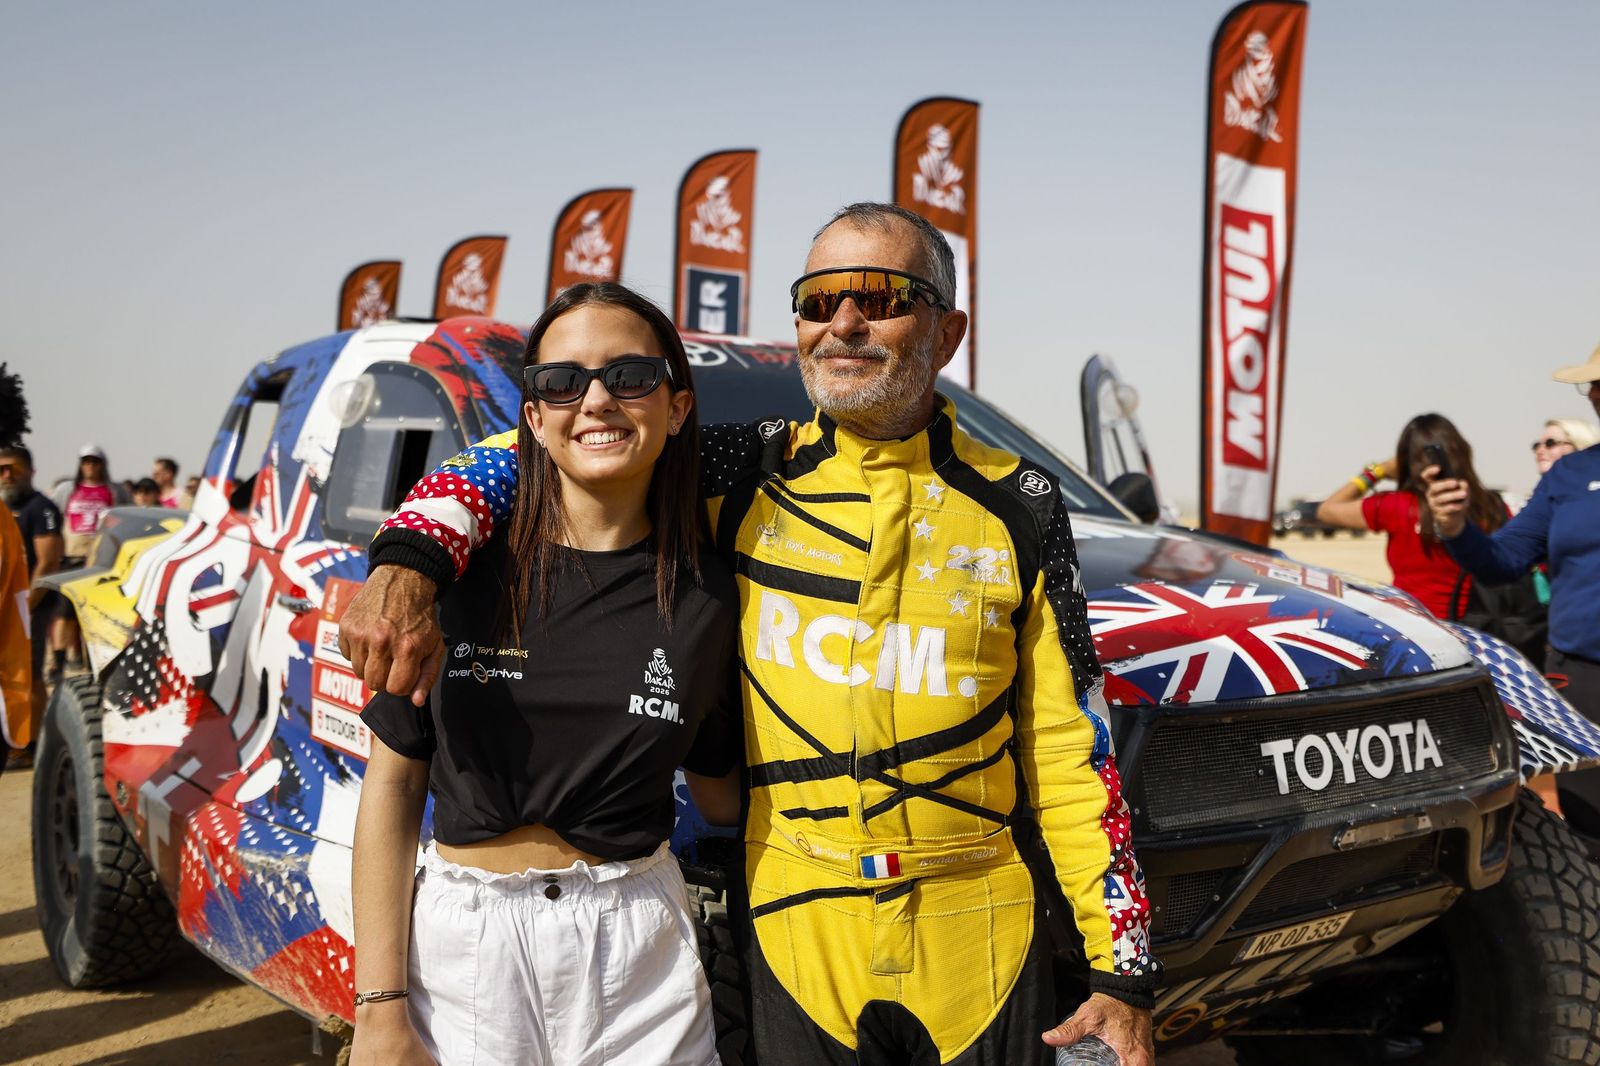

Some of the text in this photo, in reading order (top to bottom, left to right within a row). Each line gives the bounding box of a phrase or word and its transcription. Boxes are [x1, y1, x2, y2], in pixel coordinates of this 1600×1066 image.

[1224, 219, 1271, 461] MOTUL
[319, 668, 364, 707] MOTUL
[650, 686, 670, 696] 2026
[325, 714, 357, 742] TUDOR
[1260, 719, 1443, 795] TOYOTA
[1307, 916, 1347, 941] 335
